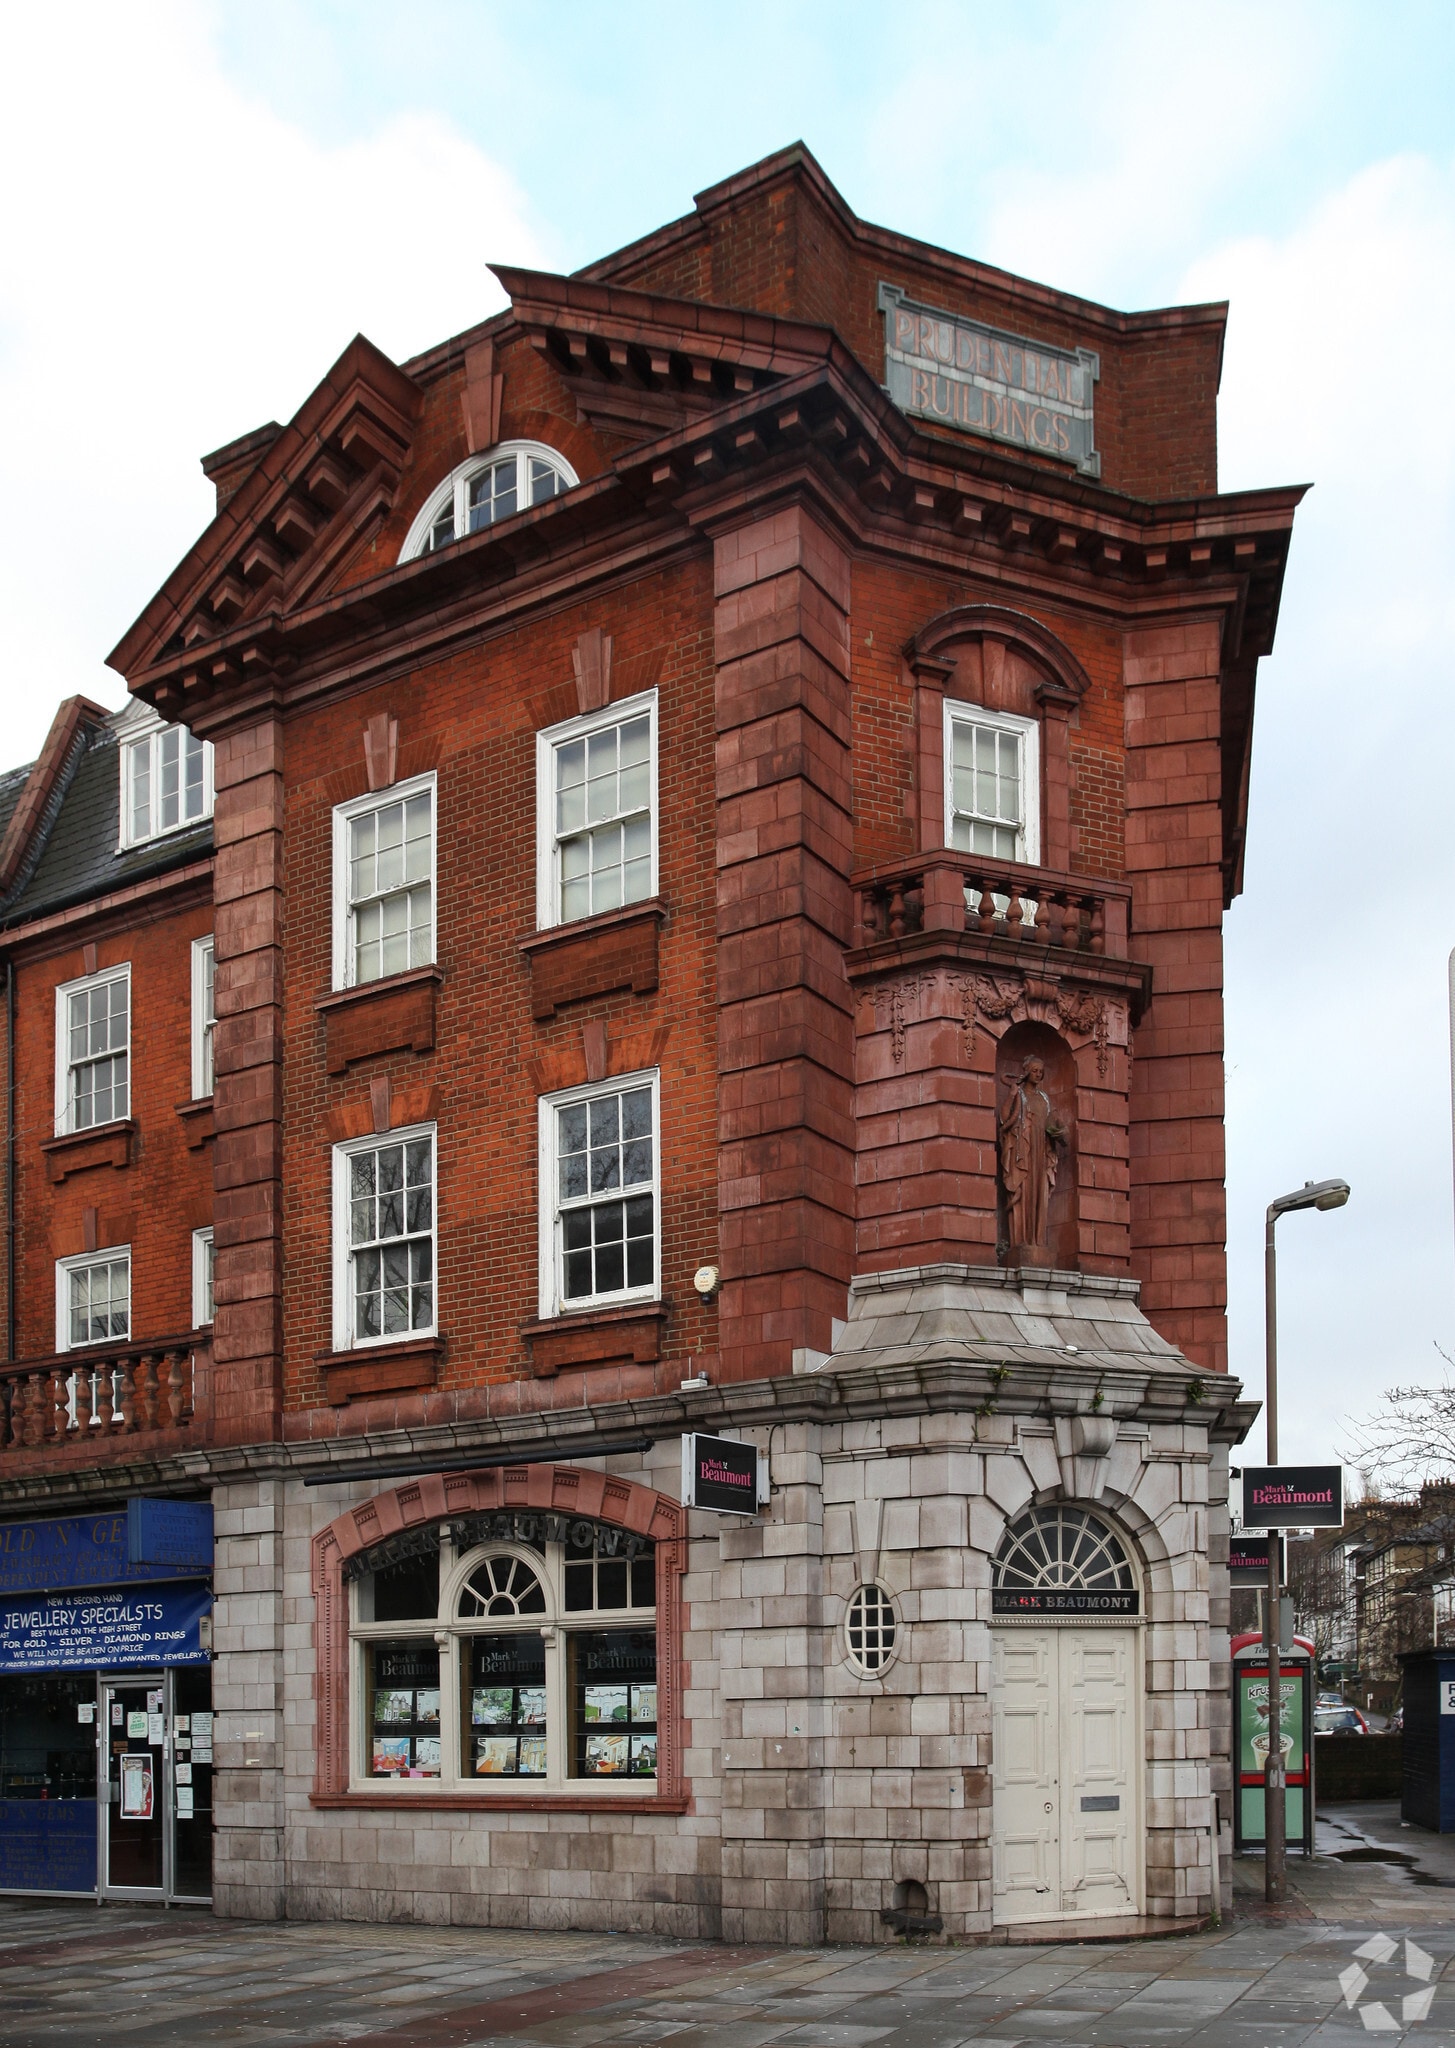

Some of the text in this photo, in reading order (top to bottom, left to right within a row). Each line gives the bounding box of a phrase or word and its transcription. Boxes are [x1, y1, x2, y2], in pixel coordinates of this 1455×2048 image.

[895, 309, 1084, 405] PRUDENTIAL
[910, 369, 1070, 452] BUILDINGS
[708, 1458, 723, 1469] Mark
[700, 1461, 751, 1487] Beaumont
[1252, 1488, 1333, 1504] Beaumont
[1264, 1485, 1287, 1493] Mark
[92, 1518, 125, 1545] GE
[349, 1514, 646, 1582] MARK BEAUMONT
[78, 1546, 124, 1567] QUALIT
[1229, 1557, 1268, 1566] aumon
[47, 1594, 123, 1607] NEW & SECOND HAND
[995, 1596, 1131, 1608] MARK BEAUMONT
[4, 1604, 163, 1630] JEWELLERY SPECIALSTS
[31, 1629, 47, 1638] BEST
[48, 1628, 70, 1636] VALUE
[83, 1626, 97, 1635] THE
[116, 1623, 142, 1633] STREET
[3, 1641, 21, 1649] FOR
[23, 1639, 47, 1648] GOLD
[59, 1636, 92, 1646] SILVER
[104, 1633, 151, 1644] DIAMOND
[154, 1631, 186, 1641] RINGS
[13, 1650, 25, 1658] WE
[27, 1650, 45, 1658] WILL
[47, 1648, 65, 1656] NOT
[65, 1648, 75, 1656] BE
[76, 1646, 106, 1655] BEATEN
[120, 1644, 144, 1653] PRICE
[391, 1654, 410, 1663] Mark
[490, 1651, 511, 1661] Mark
[6, 1660, 28, 1668] PRICES
[119, 1654, 160, 1663] UNWANTED
[162, 1652, 203, 1661] JEWELLERY
[382, 1659, 438, 1676] Beaumo
[480, 1656, 544, 1673] Beaumon
[586, 1651, 656, 1670] Beaumon
